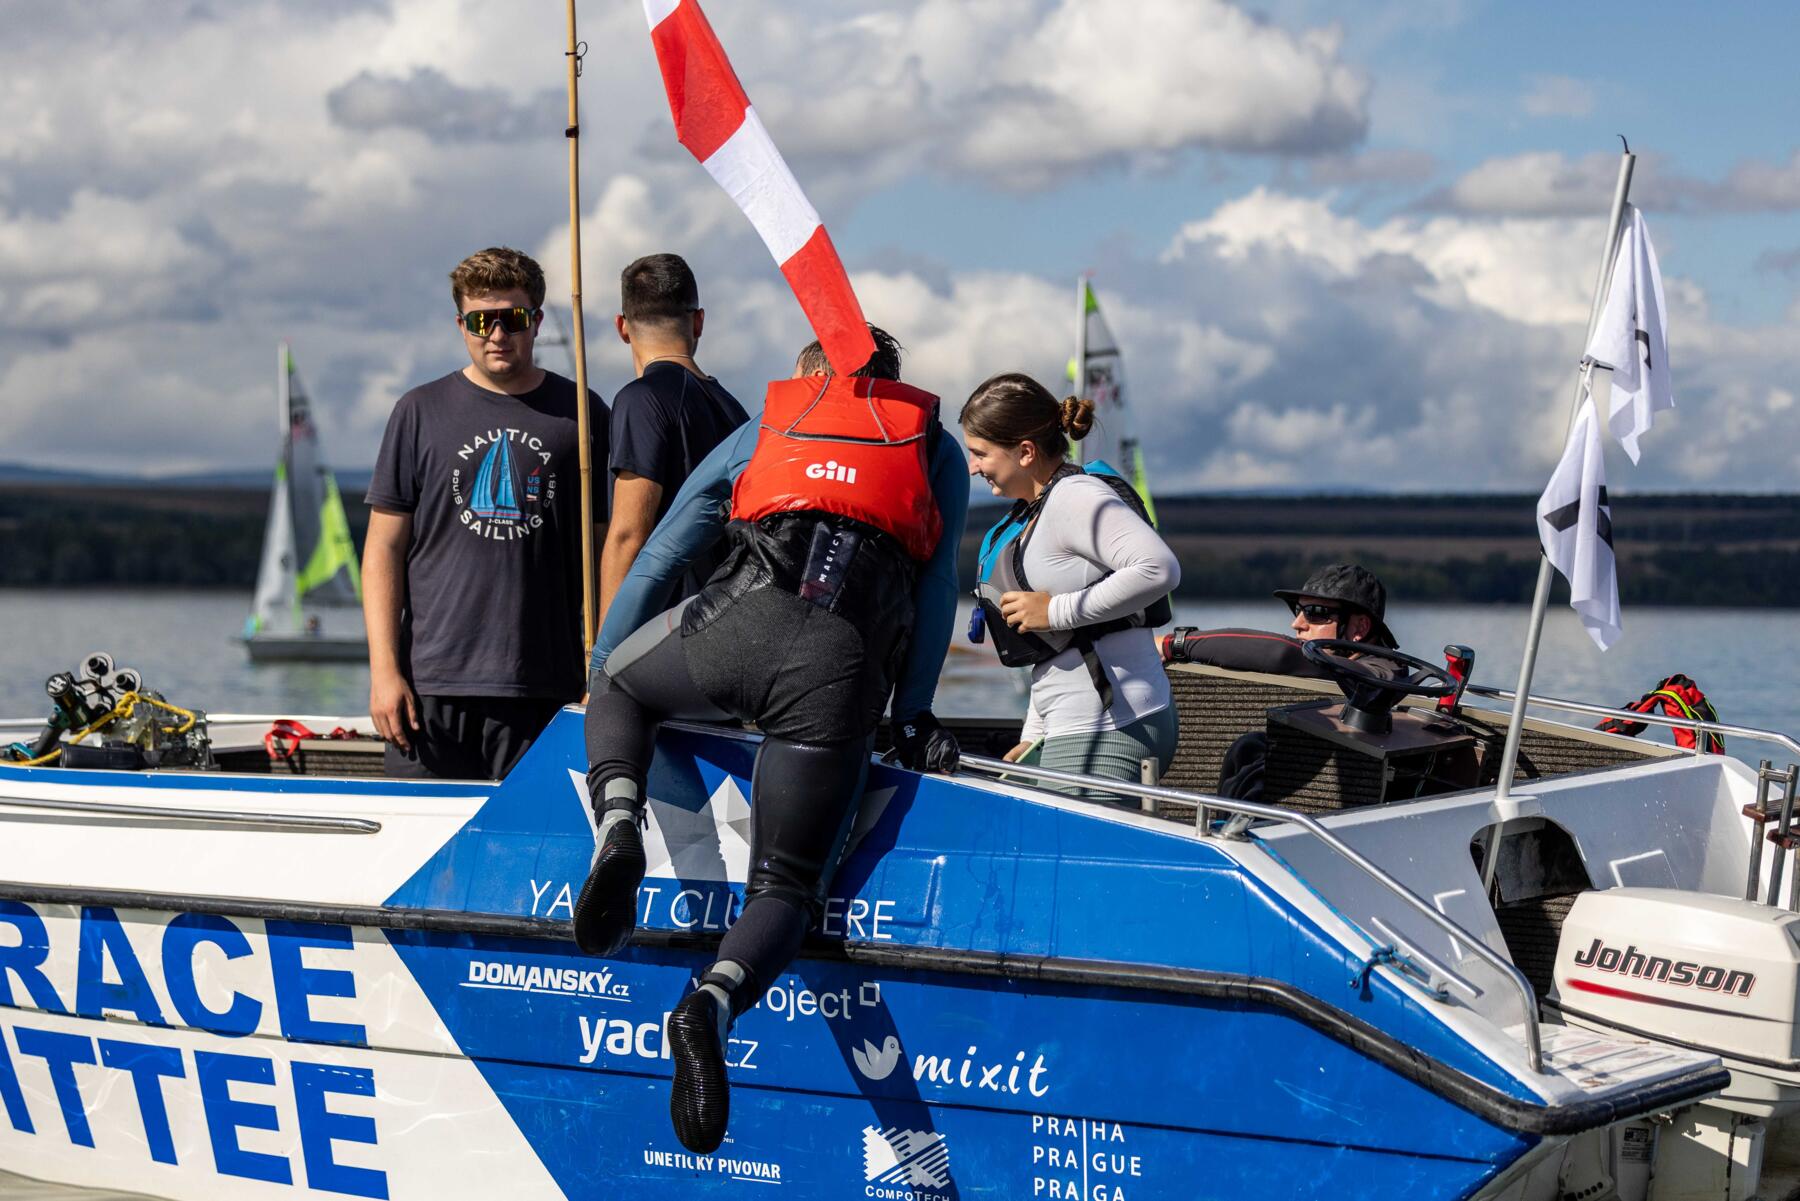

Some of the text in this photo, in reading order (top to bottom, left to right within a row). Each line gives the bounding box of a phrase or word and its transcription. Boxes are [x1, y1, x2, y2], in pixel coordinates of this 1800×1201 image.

[457, 428, 551, 465] NAUTICA
[452, 469, 463, 505] Since
[805, 460, 857, 484] Gill
[460, 509, 544, 540] SAILING
[530, 879, 661, 924] YAT
[822, 897, 896, 939] ERE
[0, 900, 368, 1048] RACE
[1574, 938, 1757, 997] Johnson
[755, 979, 852, 1021] oject
[0, 1024, 391, 1201] ITTEE
[718, 1158, 781, 1179] PIVOVAR
